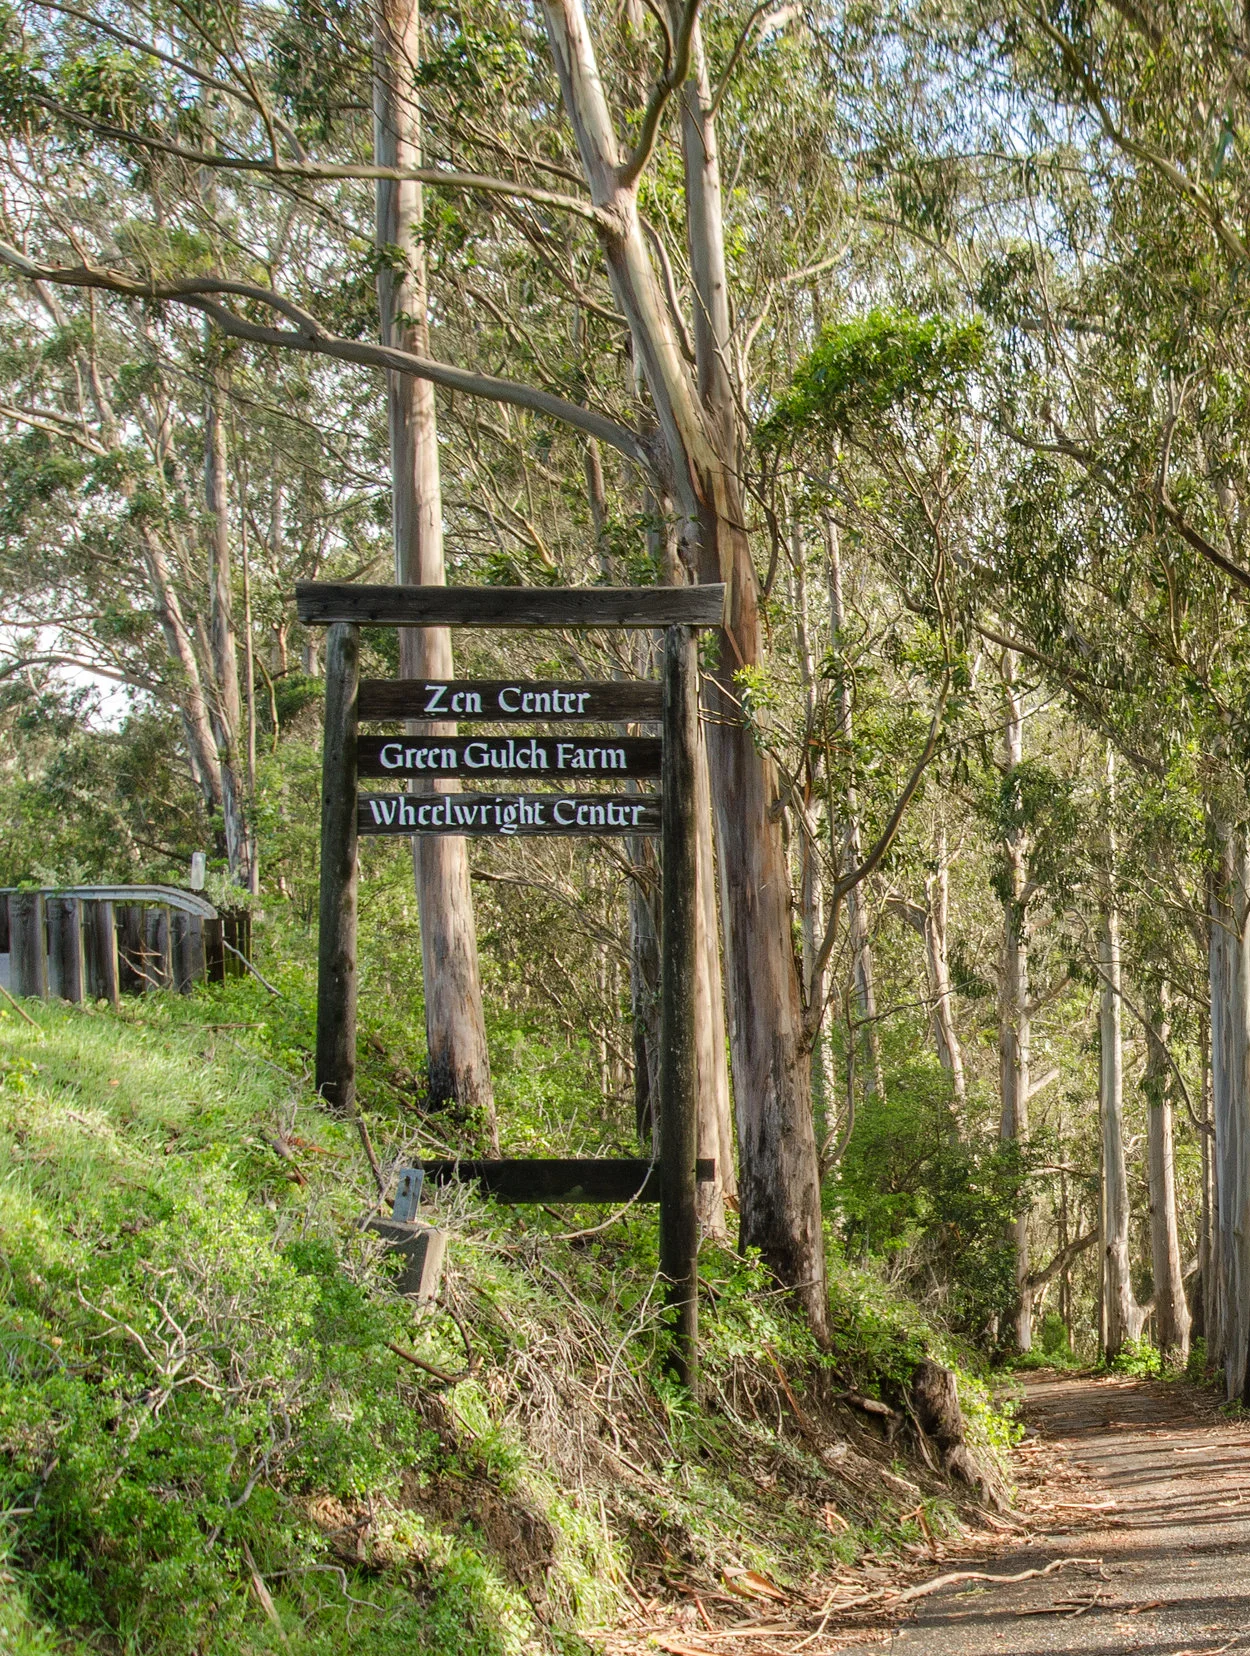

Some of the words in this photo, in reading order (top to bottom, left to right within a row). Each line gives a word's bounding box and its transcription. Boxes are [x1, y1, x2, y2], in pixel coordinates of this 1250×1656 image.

[424, 684, 483, 713] Zen
[498, 687, 591, 714] Center
[380, 743, 458, 769] Green
[463, 740, 550, 769] Gulch
[556, 743, 627, 769] Farm
[369, 797, 546, 835] Wheelwright
[553, 799, 646, 826] Center
